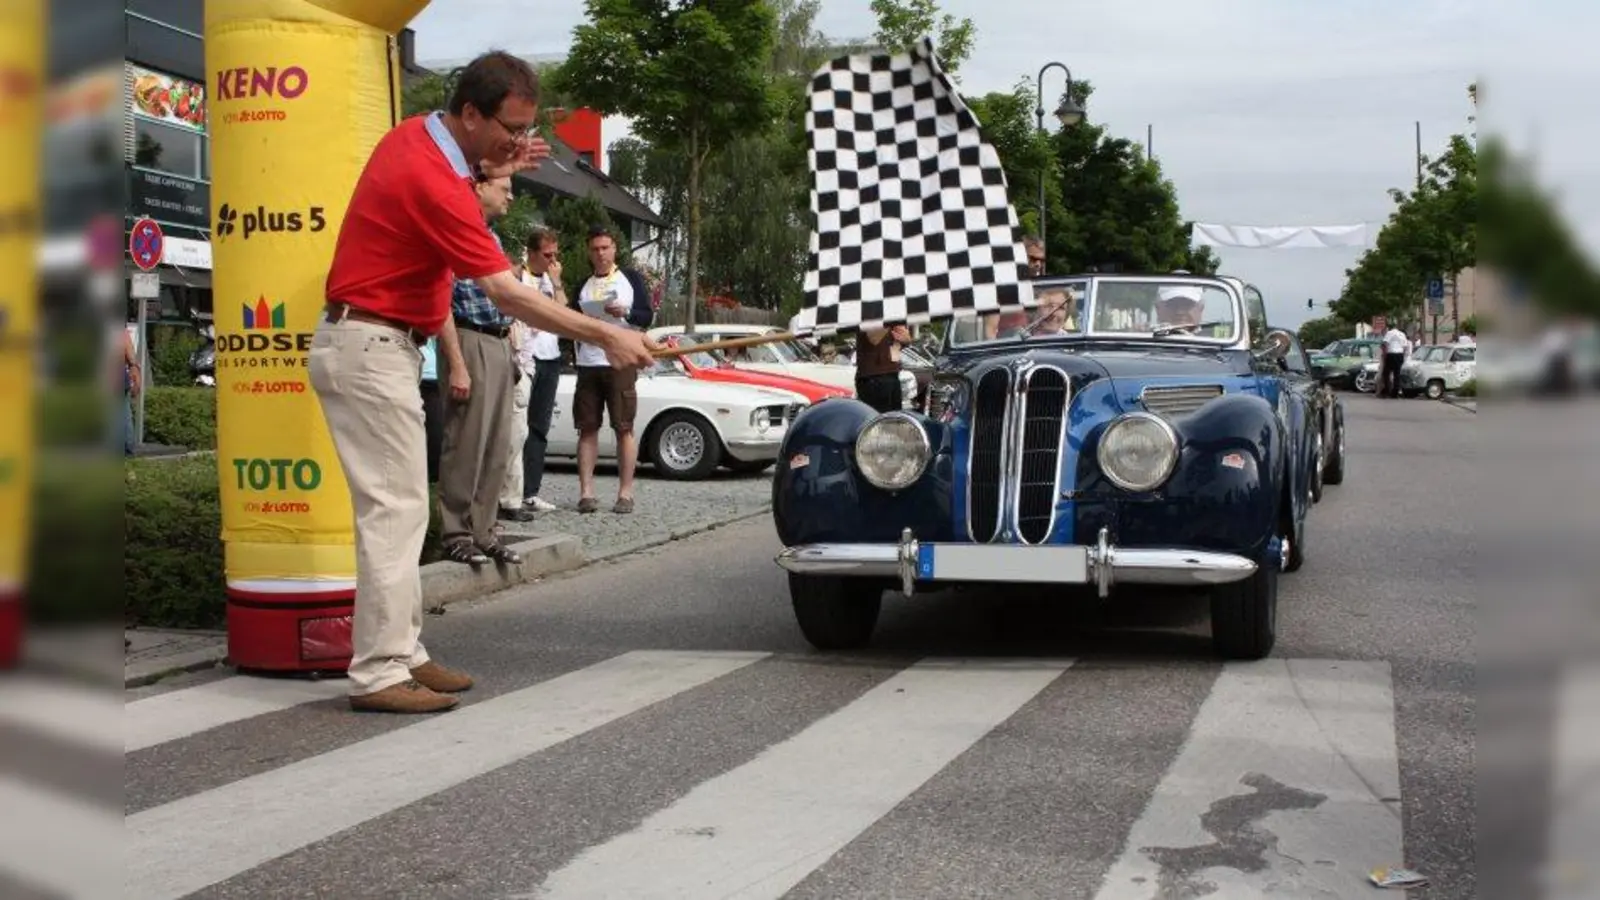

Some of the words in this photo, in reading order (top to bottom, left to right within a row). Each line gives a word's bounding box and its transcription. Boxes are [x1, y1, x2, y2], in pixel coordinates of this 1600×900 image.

[216, 65, 309, 101] KENO
[251, 110, 287, 121] LOTTO
[242, 207, 303, 240] plus
[310, 207, 326, 232] 5
[217, 332, 314, 353] ODDSE
[233, 356, 309, 368] SPORTWE
[266, 381, 306, 393] LOTTO
[232, 457, 322, 491] TOTO
[274, 502, 310, 513] LOTTO
